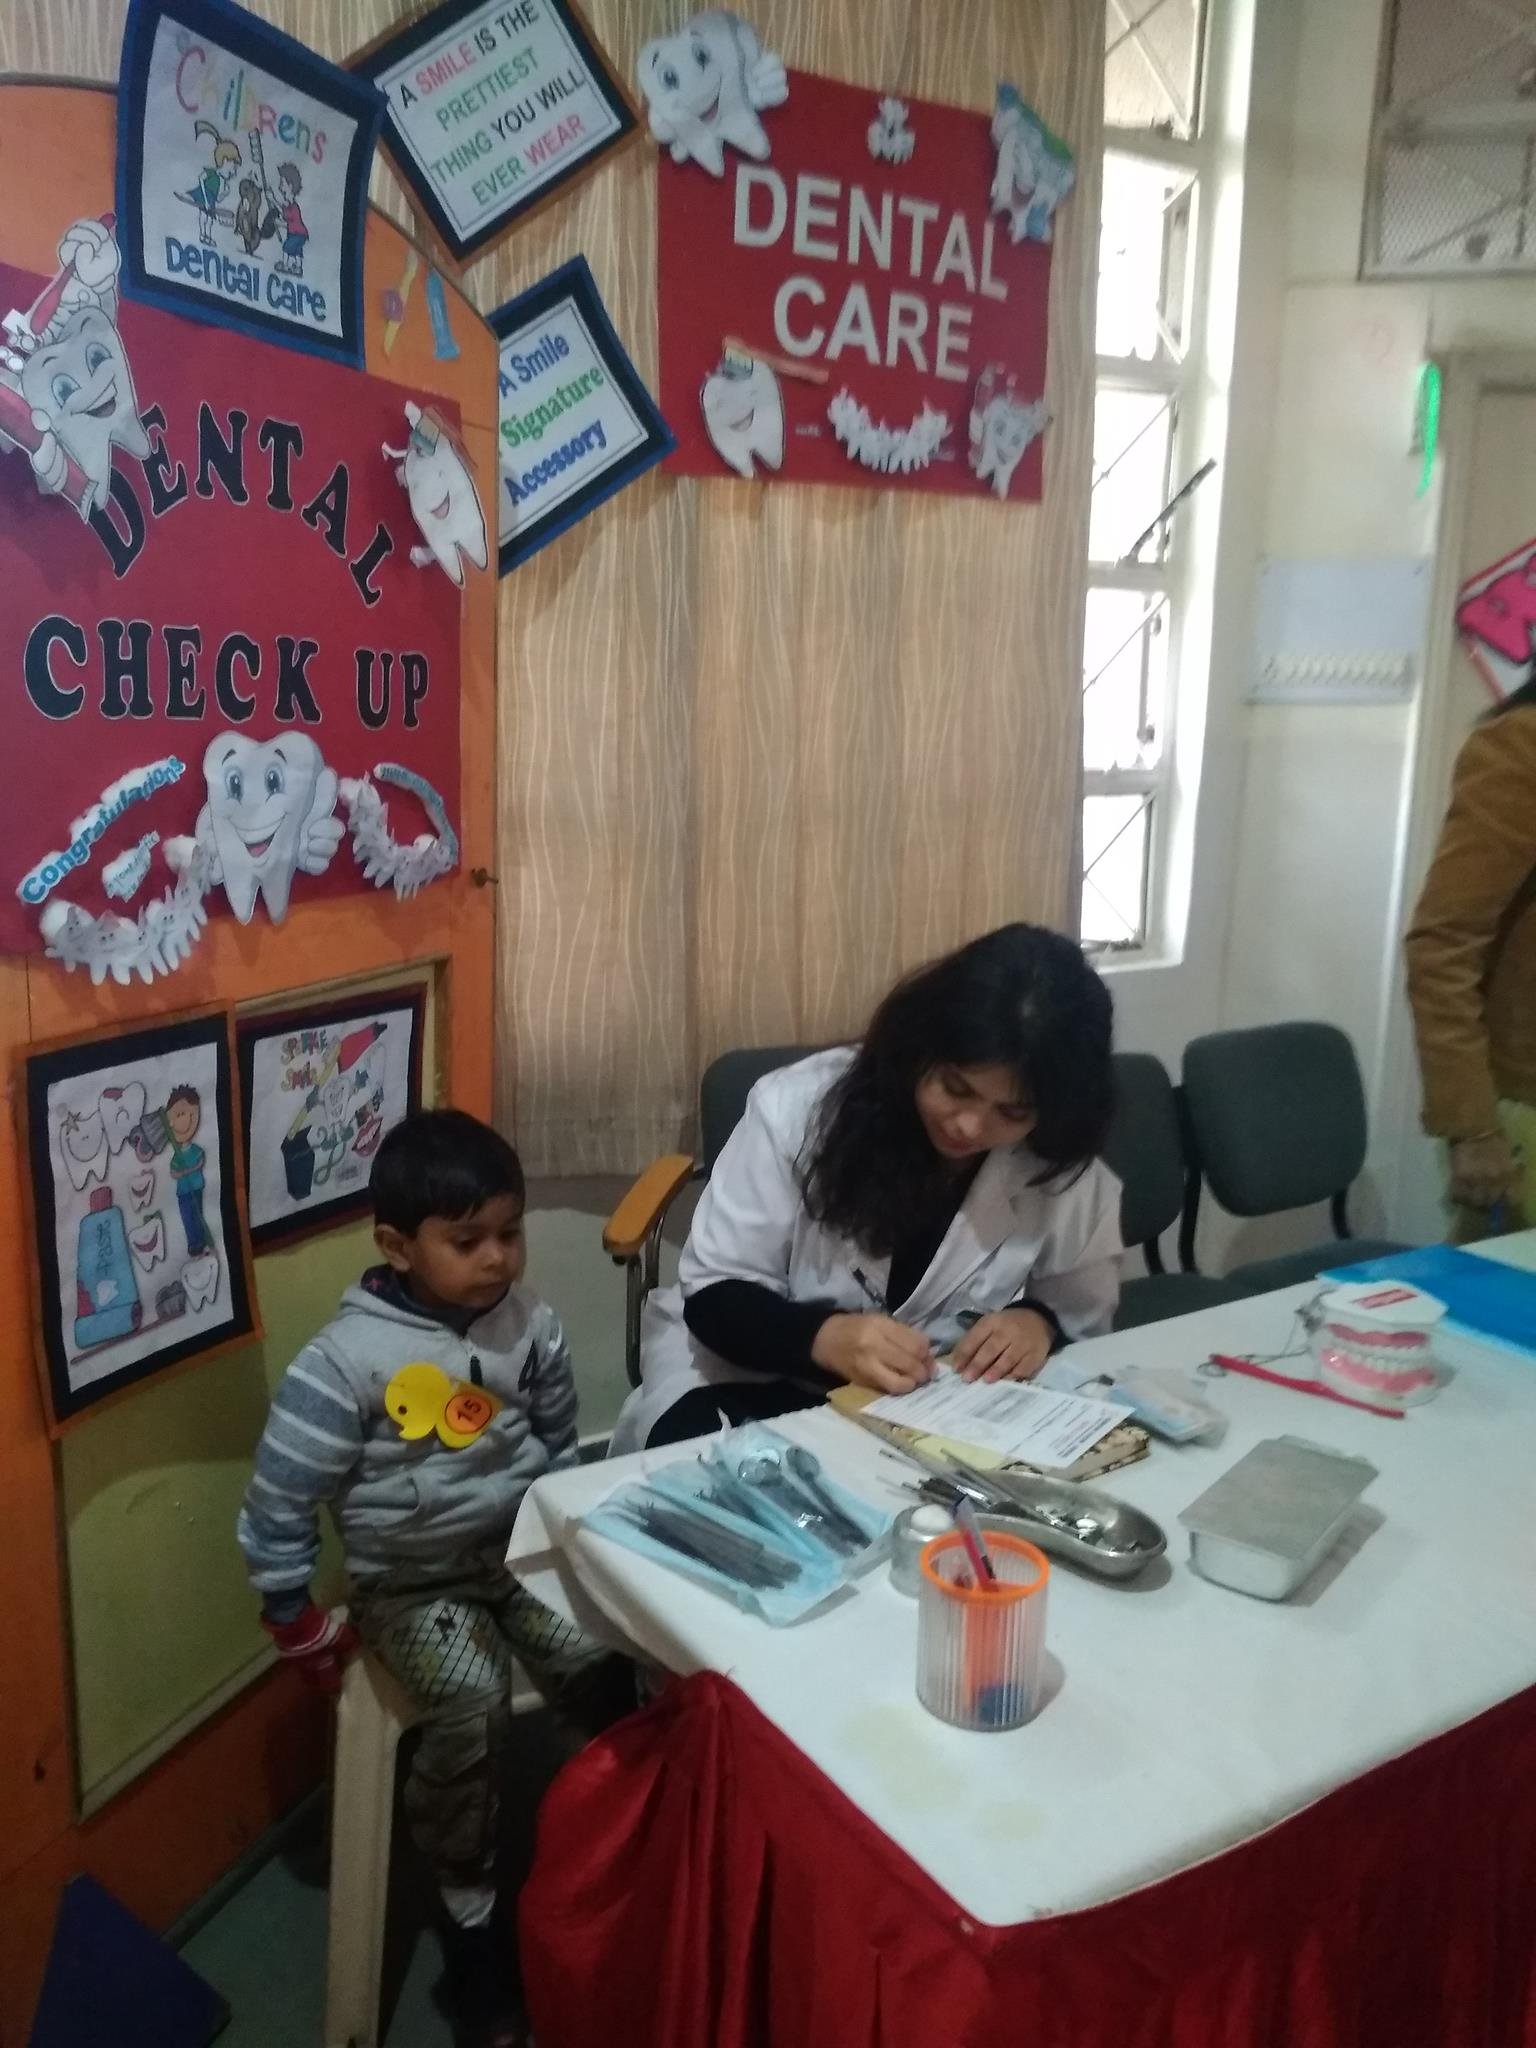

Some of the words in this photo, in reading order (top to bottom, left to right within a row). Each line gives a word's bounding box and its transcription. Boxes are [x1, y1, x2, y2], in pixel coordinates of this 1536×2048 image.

[400, 83, 418, 109] A
[415, 41, 477, 95] SMILE
[473, 27, 497, 56] IS
[494, 1, 540, 38] THE
[435, 47, 539, 131] PRETTIEST
[430, 129, 493, 184] THING
[490, 100, 536, 140] YOU
[535, 69, 587, 110] WILL
[471, 156, 526, 206] EVER
[523, 113, 586, 166] WEAR
[164, 236, 260, 301] Dental
[733, 164, 1008, 300] DENTAL
[498, 369, 518, 399] A
[510, 334, 570, 383] Smile
[773, 276, 973, 382] CARE
[500, 367, 604, 447] Signature
[85, 401, 394, 608] DENTAL
[504, 419, 607, 507] Accessory
[23, 615, 322, 724] CHECK
[354, 649, 429, 730] UP
[22, 756, 184, 901] Congratulations
[456, 1399, 482, 1423] 15
